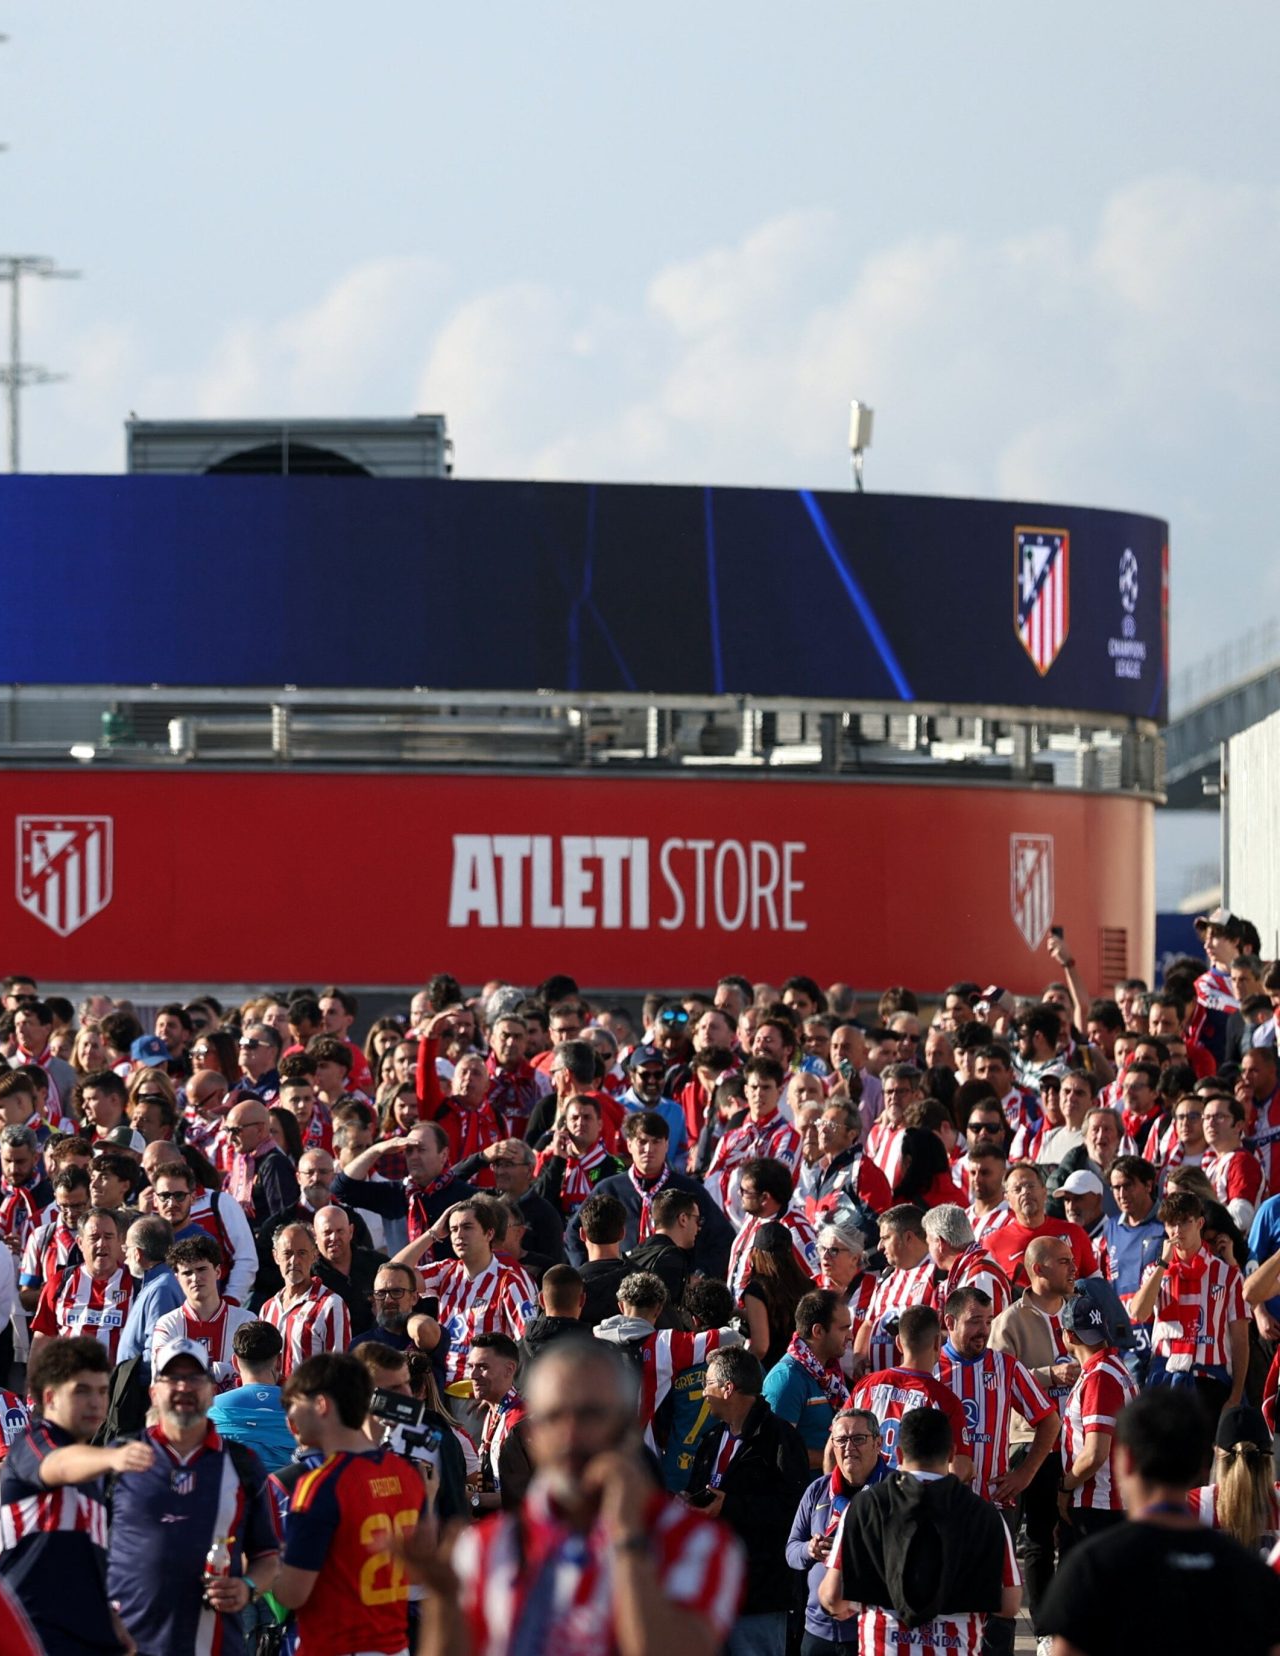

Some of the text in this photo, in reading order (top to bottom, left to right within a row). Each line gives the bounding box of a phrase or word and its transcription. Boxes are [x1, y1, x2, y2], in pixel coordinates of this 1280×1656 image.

[448, 833, 807, 930] ATLETI STORE
[67, 1314, 121, 1325] Pls500
[674, 1369, 707, 1390] GRIEZ
[891, 1631, 962, 1648] RWANDA
